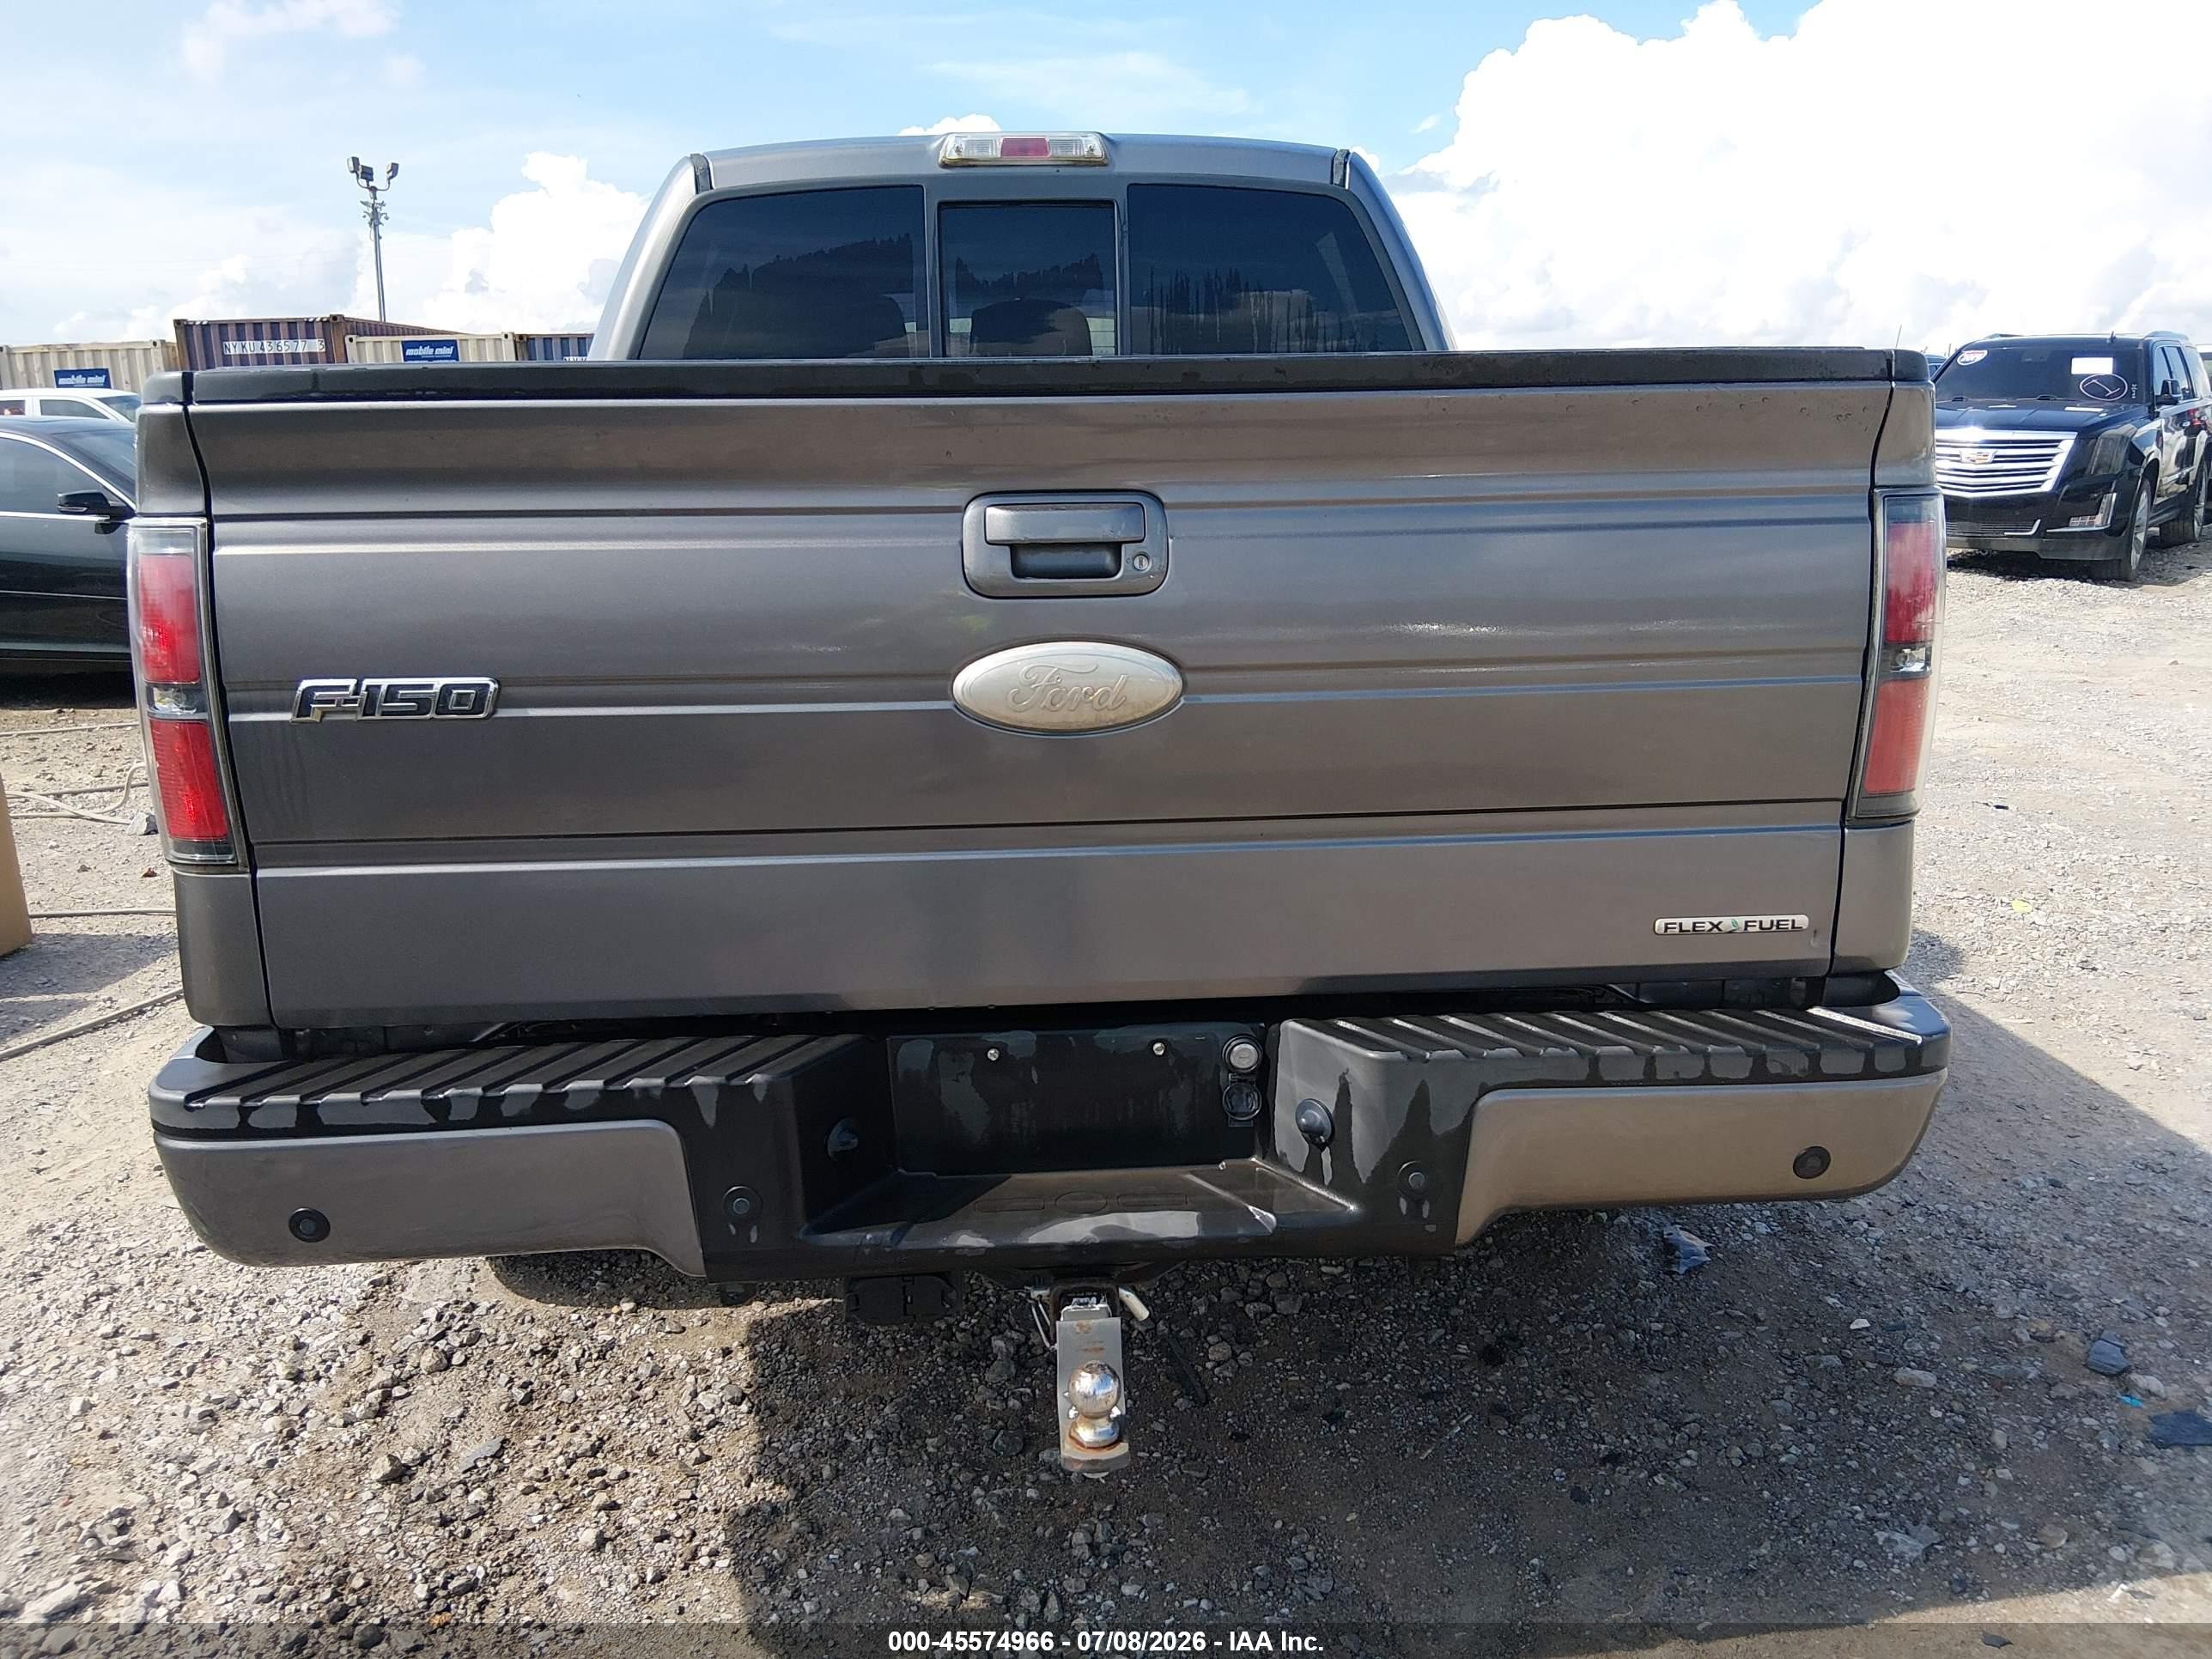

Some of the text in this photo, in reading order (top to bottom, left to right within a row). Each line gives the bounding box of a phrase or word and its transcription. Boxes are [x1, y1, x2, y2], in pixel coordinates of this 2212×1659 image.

[224, 339, 325, 354] NYKU 436577 3
[405, 345, 454, 356] mobile mini
[58, 374, 87, 385] mobile
[1006, 663, 1130, 713] Ford
[289, 677, 500, 723] F-150
[1663, 919, 1803, 933] FLEX FUEL
